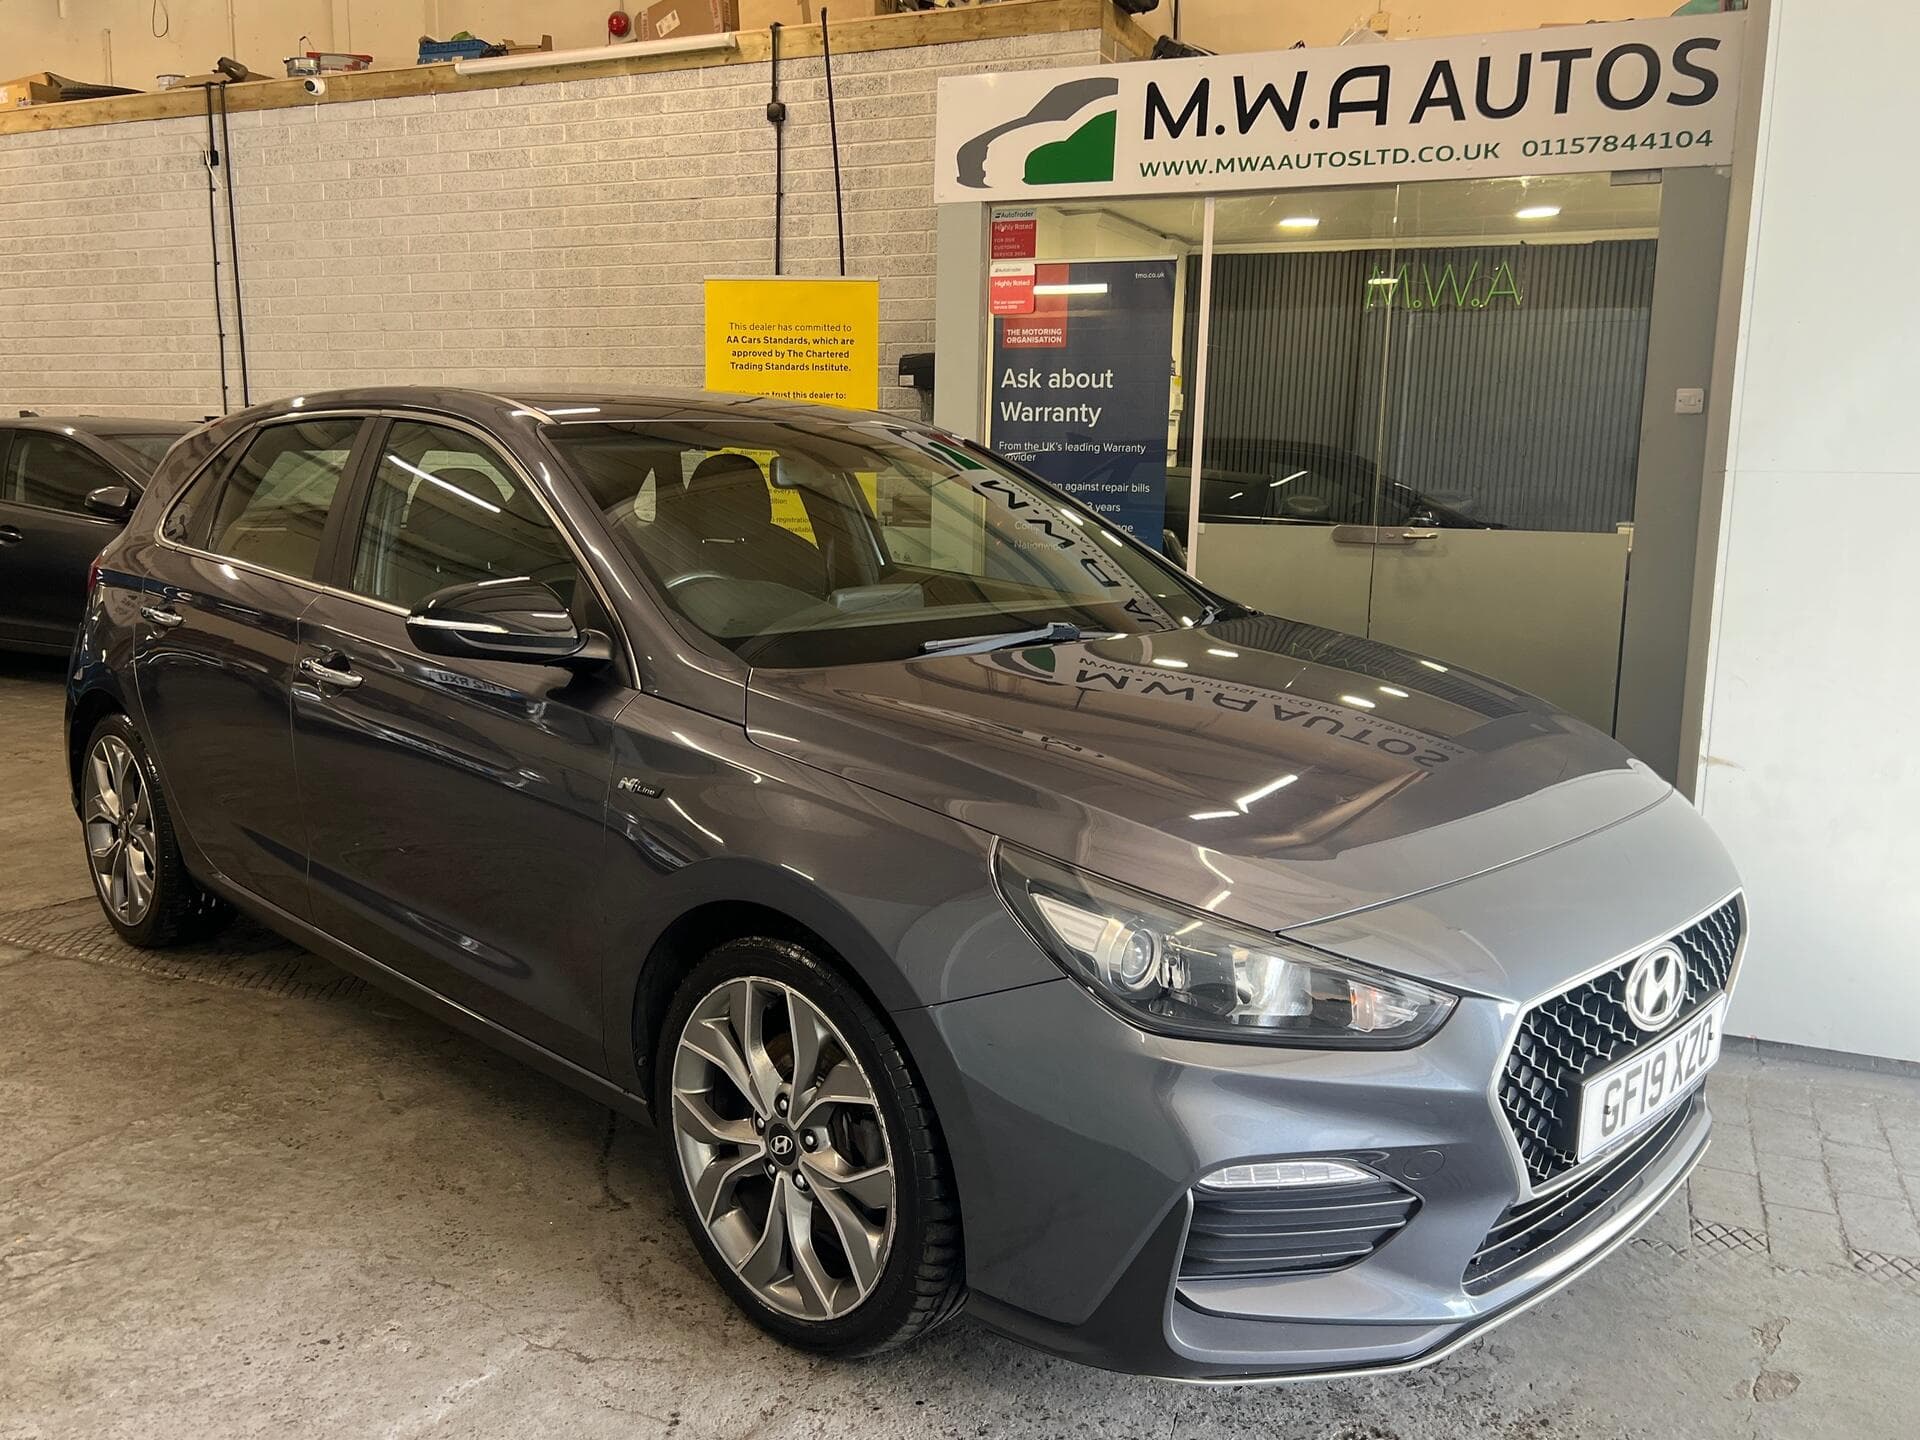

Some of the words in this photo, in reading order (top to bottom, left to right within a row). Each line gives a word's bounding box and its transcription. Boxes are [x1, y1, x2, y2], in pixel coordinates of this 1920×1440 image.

[1144, 64, 1390, 140] M.W.A
[1409, 37, 1721, 124] AUTOS
[1139, 141, 1500, 178] WWW.MWAAUTOSLTD.CO.UK
[1521, 129, 1714, 159] 01157844104
[730, 323, 747, 331] This
[749, 323, 776, 331] dealer
[778, 323, 793, 331] has
[795, 324, 841, 332] committed
[842, 324, 852, 332] to
[726, 336, 739, 344] AA
[741, 336, 761, 344] Cars
[763, 336, 811, 345] Standards,
[812, 337, 839, 345] which
[1006, 336, 1062, 344] ORGANISATION
[731, 350, 773, 358] approved
[775, 350, 785, 359] by
[787, 350, 804, 358] The
[805, 350, 850, 358] Chartered
[730, 362, 763, 372] Trading
[765, 362, 810, 371] Standards
[811, 363, 852, 372] Institute.
[1001, 368, 1041, 388] Ask
[1048, 369, 1114, 389] about
[792, 391, 807, 399] this
[808, 391, 834, 399] dealer
[836, 391, 847, 400] to:
[1000, 401, 1102, 427] Warranty
[999, 441, 1022, 451] From
[1024, 441, 1039, 451] the
[1042, 442, 1062, 451] UK's
[1065, 442, 1100, 454] leading
[1103, 443, 1146, 454] Warranty
[1065, 482, 1099, 493] against
[1101, 482, 1129, 493] repair
[1131, 482, 1150, 493] bills
[1095, 504, 1121, 512] years
[1601, 1050, 1667, 1137] GF19
[1670, 1013, 1713, 1093] XZO
